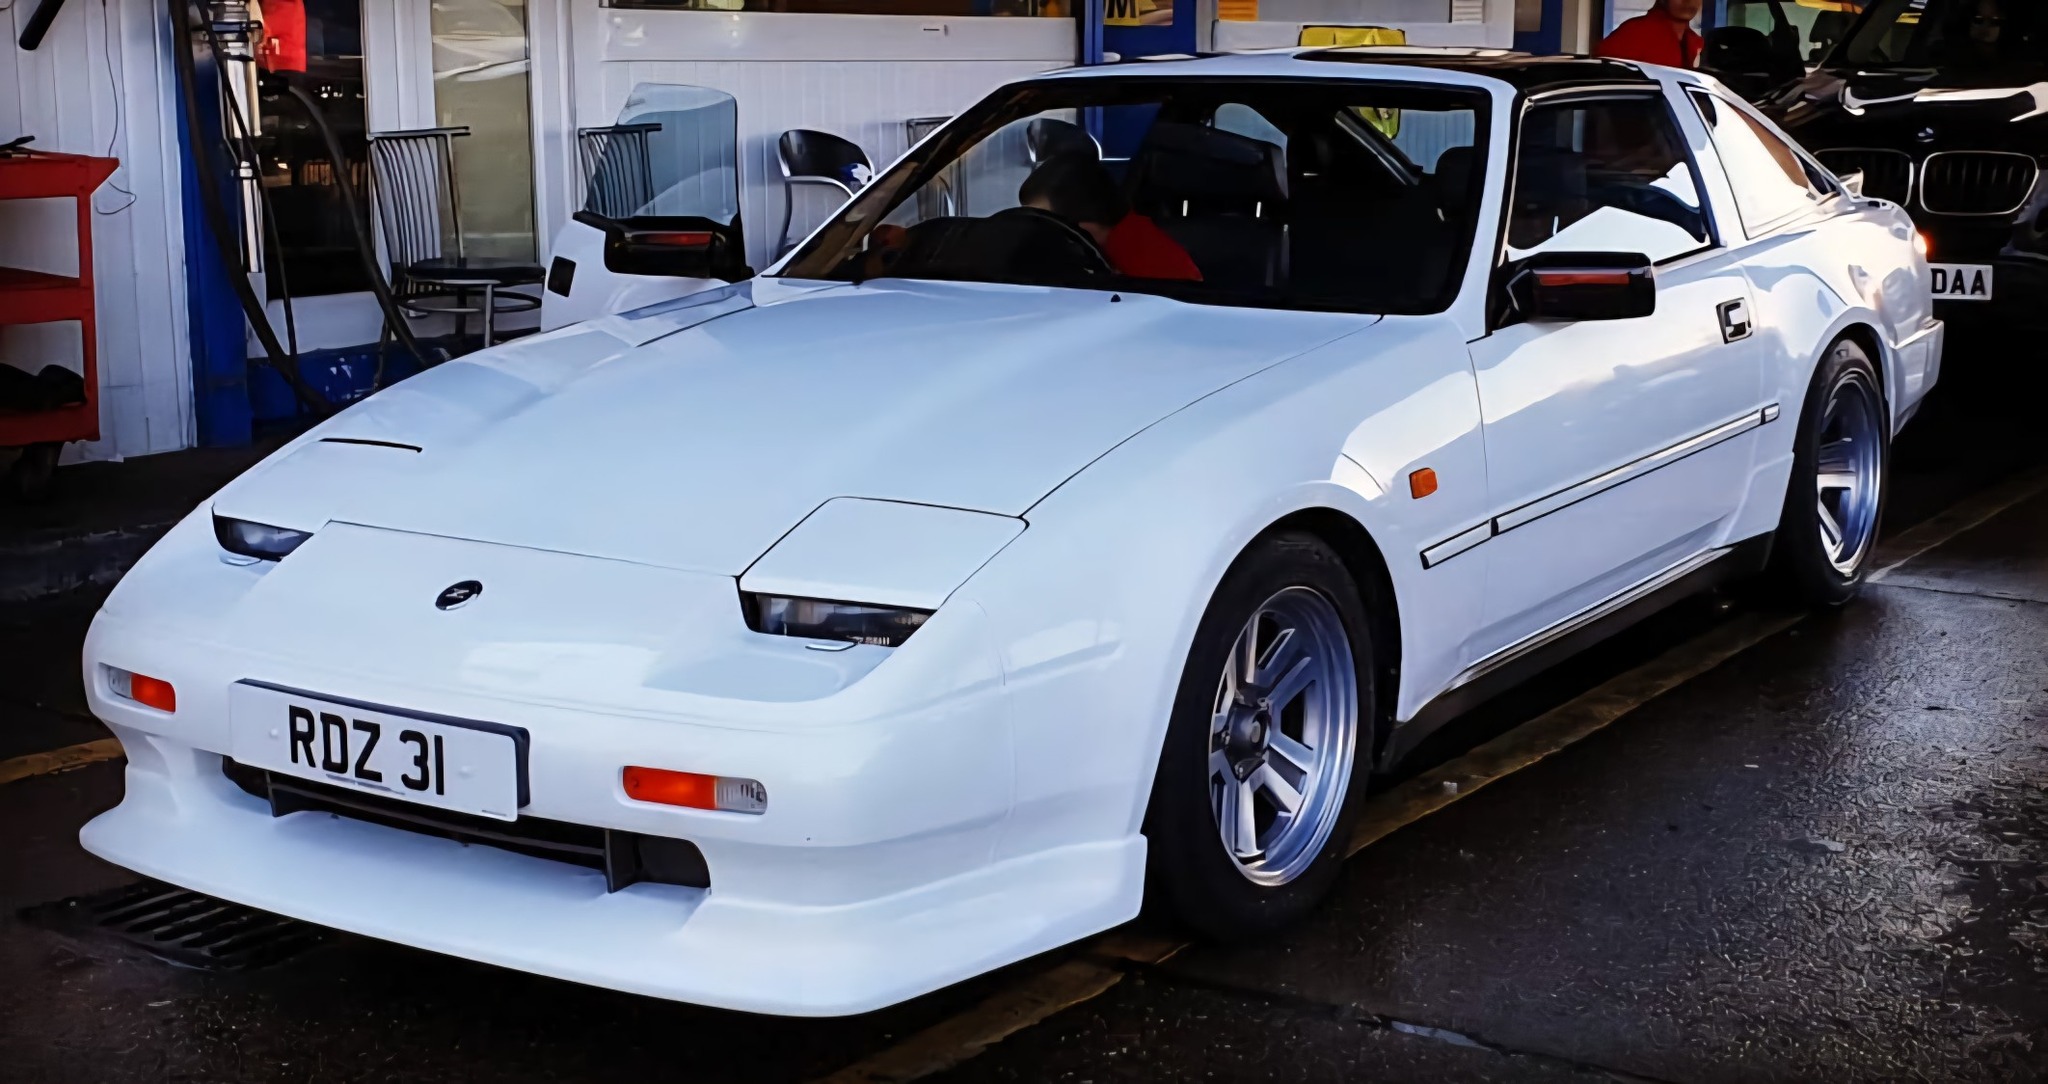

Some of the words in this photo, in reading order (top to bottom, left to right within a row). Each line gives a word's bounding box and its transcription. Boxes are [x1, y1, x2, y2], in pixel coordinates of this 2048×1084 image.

[1931, 268, 1986, 295] DAA
[289, 704, 383, 783] RDZ
[399, 729, 445, 796] 31
